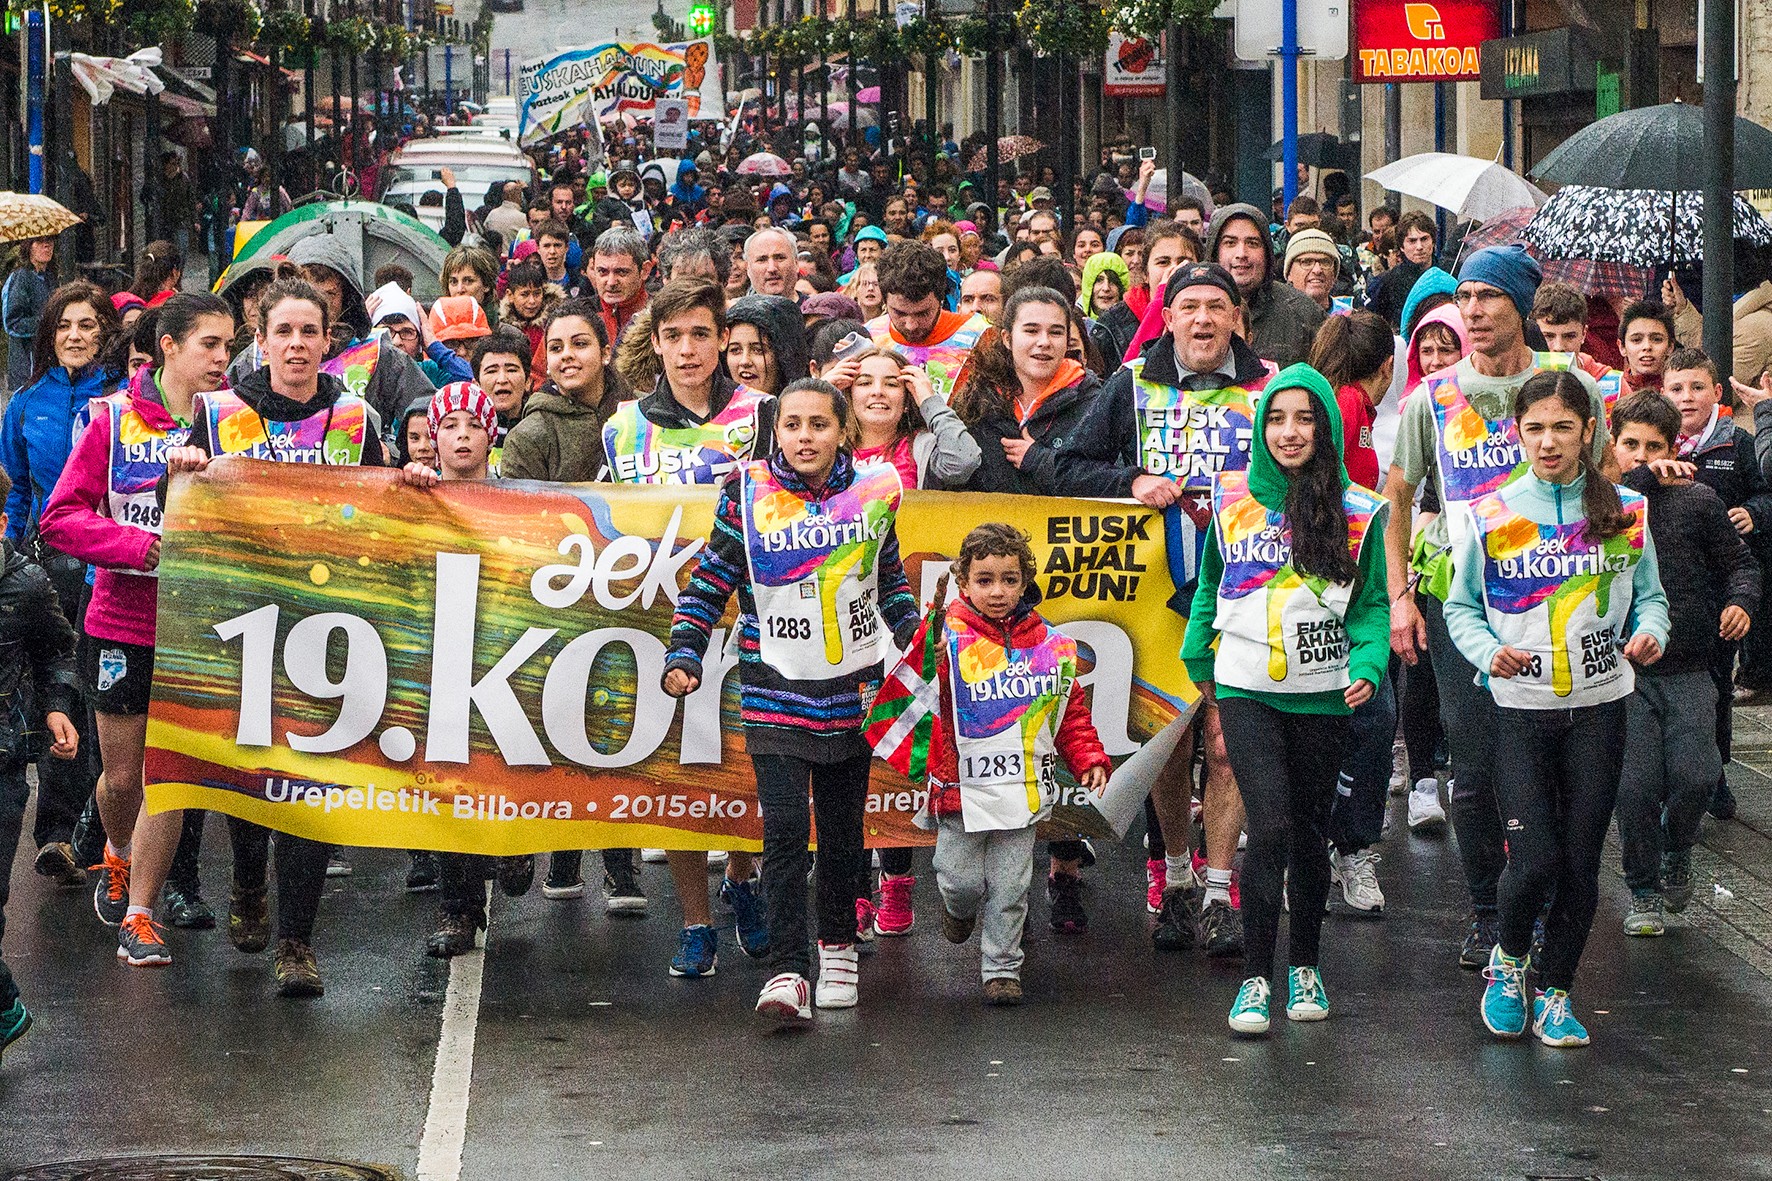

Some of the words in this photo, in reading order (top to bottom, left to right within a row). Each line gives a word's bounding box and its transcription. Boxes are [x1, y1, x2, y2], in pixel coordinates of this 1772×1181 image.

[1358, 47, 1480, 77] TABAKOA
[1144, 406, 1231, 430] EUSK
[1144, 427, 1231, 454] AHAL
[1487, 425, 1510, 447] aek
[614, 445, 706, 481] EUSK
[123, 502, 161, 528] 1249
[804, 508, 834, 527] aek
[1047, 514, 1153, 544] EUSK
[1224, 532, 1291, 564] 19.kor
[1535, 533, 1569, 556] aek
[530, 505, 705, 611] aek
[1044, 543, 1147, 574] AHAL
[1493, 544, 1631, 580] 19.korrika
[1045, 572, 1140, 602] DUN!
[766, 615, 812, 640] 1283
[1296, 630, 1343, 650] AHAL
[1581, 623, 1617, 650] EUSK
[1005, 656, 1033, 677] aek
[1300, 644, 1343, 665] DUN!
[1584, 653, 1618, 679] DUN!
[963, 753, 1022, 779] 1283
[264, 777, 442, 816] Urepeletik
[452, 794, 573, 821] Bilbora
[609, 793, 748, 819] 2015eko
